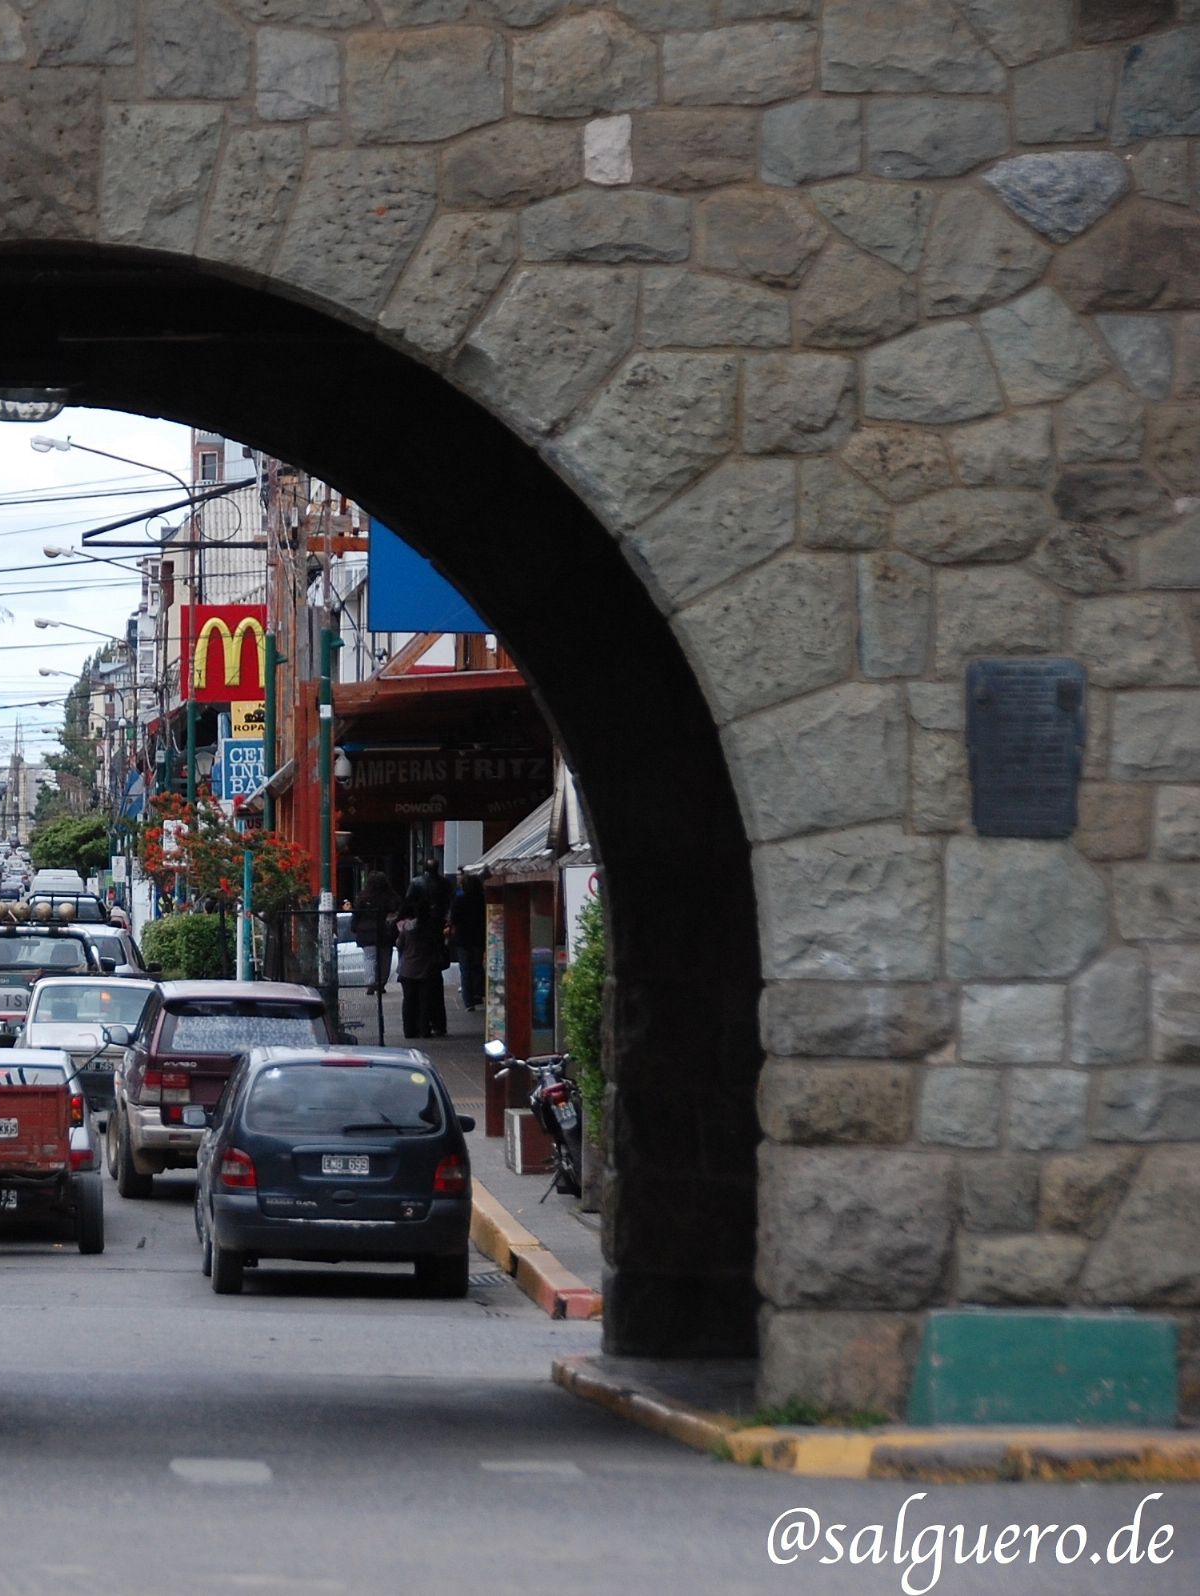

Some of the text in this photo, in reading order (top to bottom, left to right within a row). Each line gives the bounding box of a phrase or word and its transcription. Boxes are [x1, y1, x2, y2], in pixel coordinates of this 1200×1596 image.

[234, 724, 264, 732] ROPA
[454, 757, 546, 781] FRITZ
[395, 802, 443, 814] POWDER
